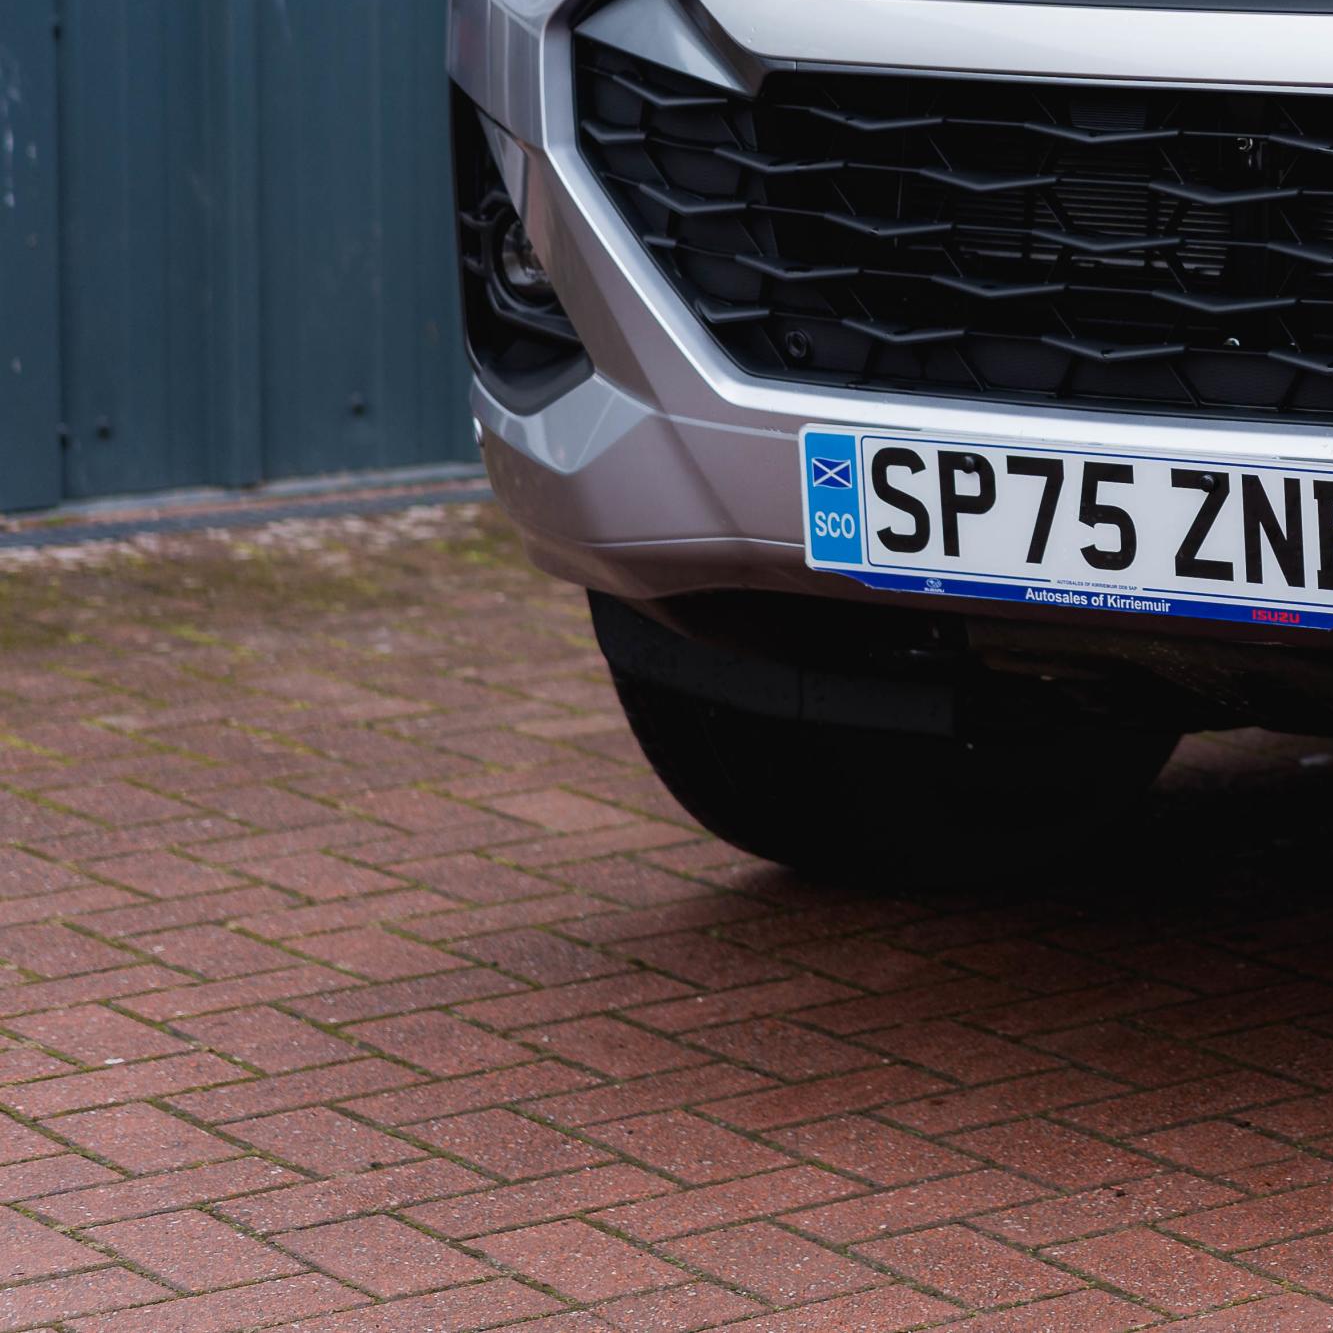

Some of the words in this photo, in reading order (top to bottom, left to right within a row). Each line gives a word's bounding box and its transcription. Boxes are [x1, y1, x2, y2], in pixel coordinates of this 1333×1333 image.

[871, 446, 1137, 571] SP75
[814, 510, 855, 539] SCO
[1025, 587, 1088, 606] Autosales
[1091, 593, 1104, 607] of
[1107, 595, 1171, 613] Kirriemuir
[1252, 609, 1300, 624] ISUZU
